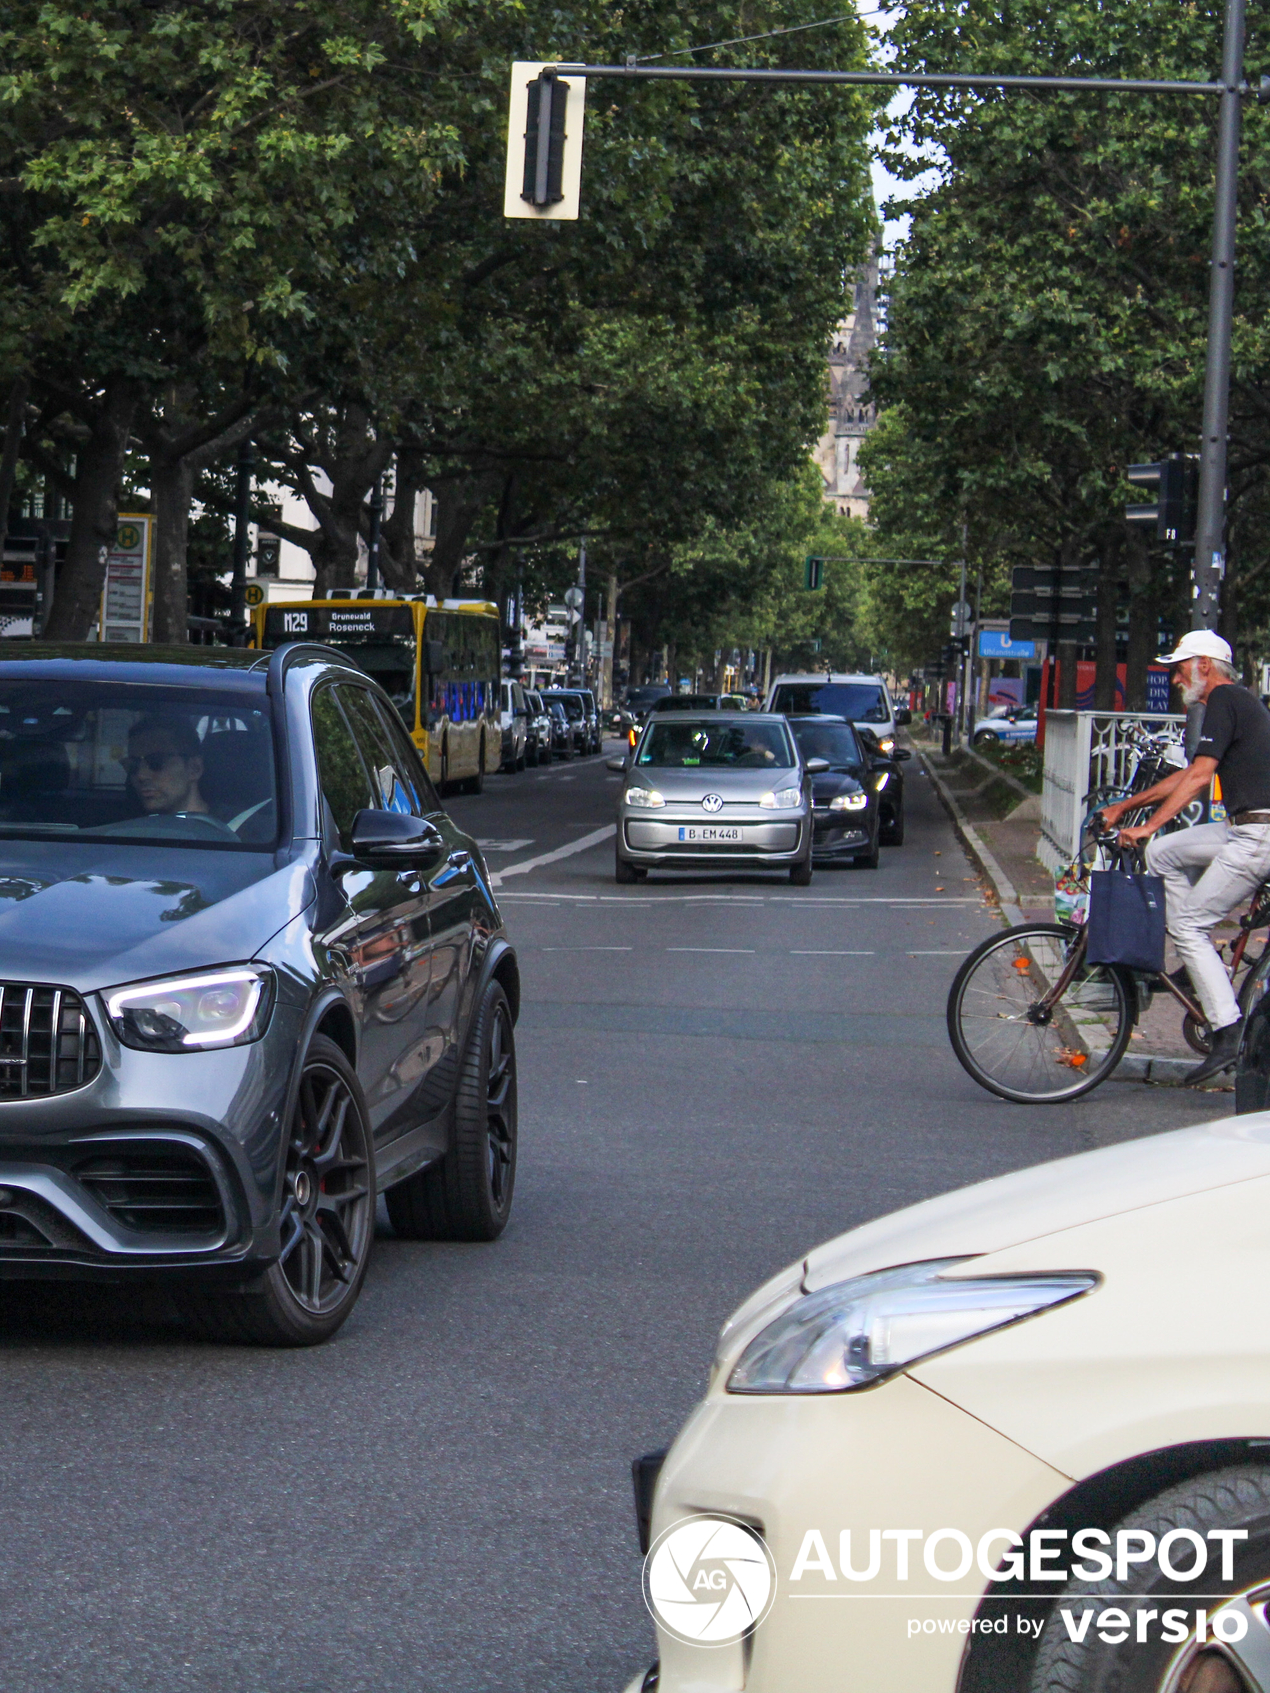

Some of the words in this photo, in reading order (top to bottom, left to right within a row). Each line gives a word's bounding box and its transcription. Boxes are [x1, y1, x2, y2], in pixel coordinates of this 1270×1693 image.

[1166, 528, 1176, 540] F8
[331, 612, 372, 621] Grunewald
[284, 612, 308, 632] M29
[329, 622, 375, 632] Roseneck
[689, 829, 696, 839] B
[703, 829, 717, 839] EM
[719, 829, 738, 839] 448
